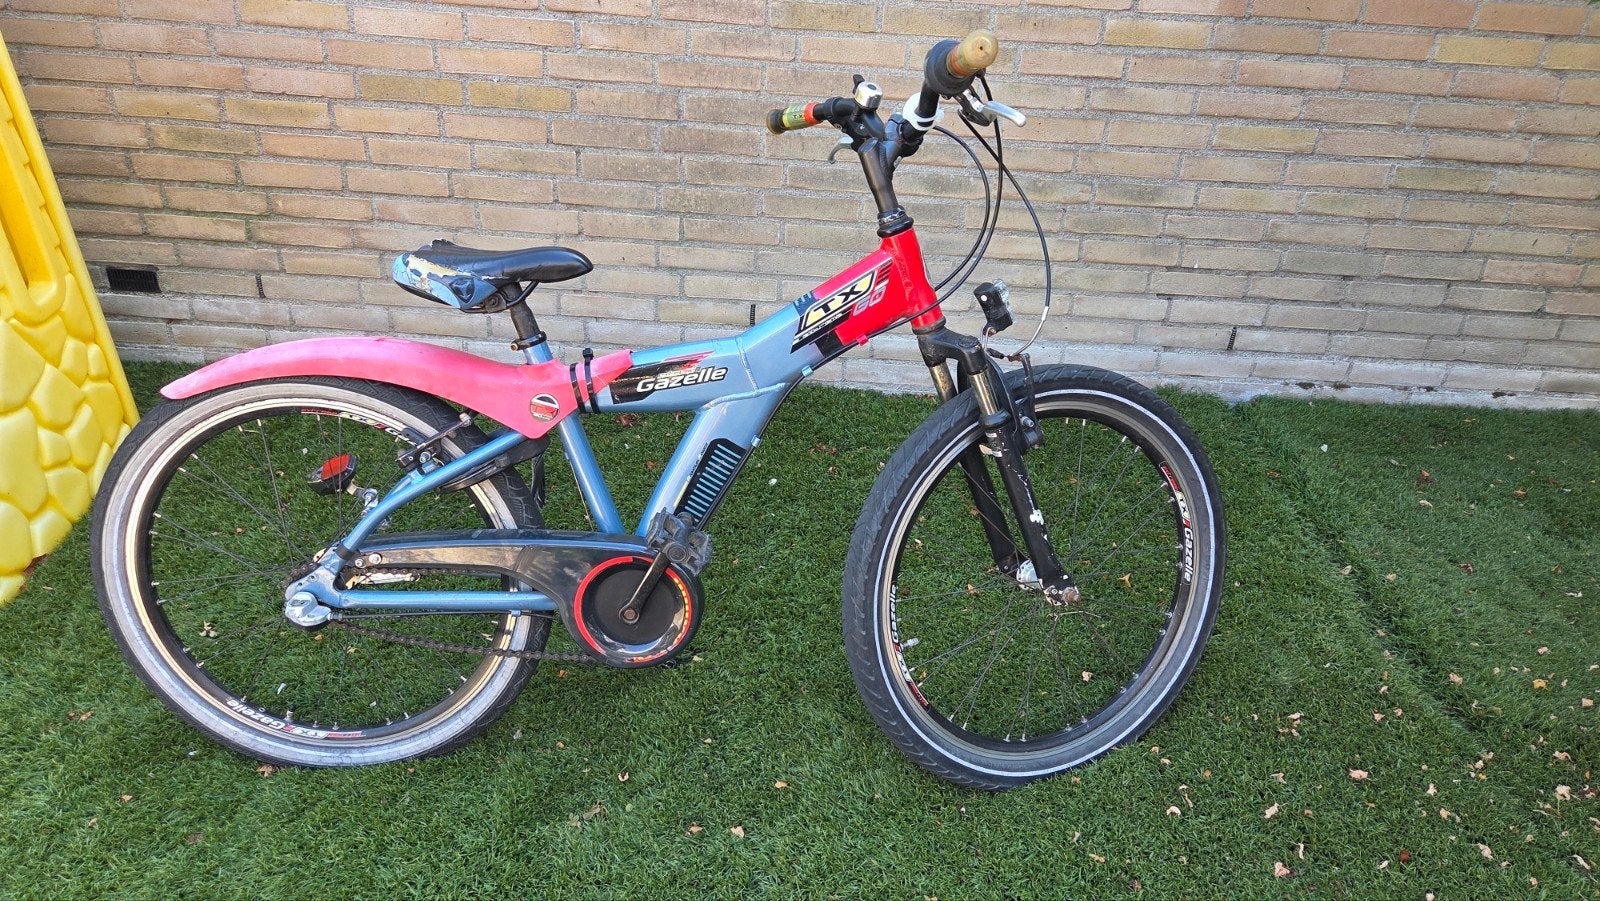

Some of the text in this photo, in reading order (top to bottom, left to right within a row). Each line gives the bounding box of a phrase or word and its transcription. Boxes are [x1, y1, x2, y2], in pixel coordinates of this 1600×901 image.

[813, 283, 863, 315] TX
[636, 366, 728, 393] Gazelle
[1184, 527, 1194, 582] Gazelle
[226, 698, 286, 730] Gazelle
